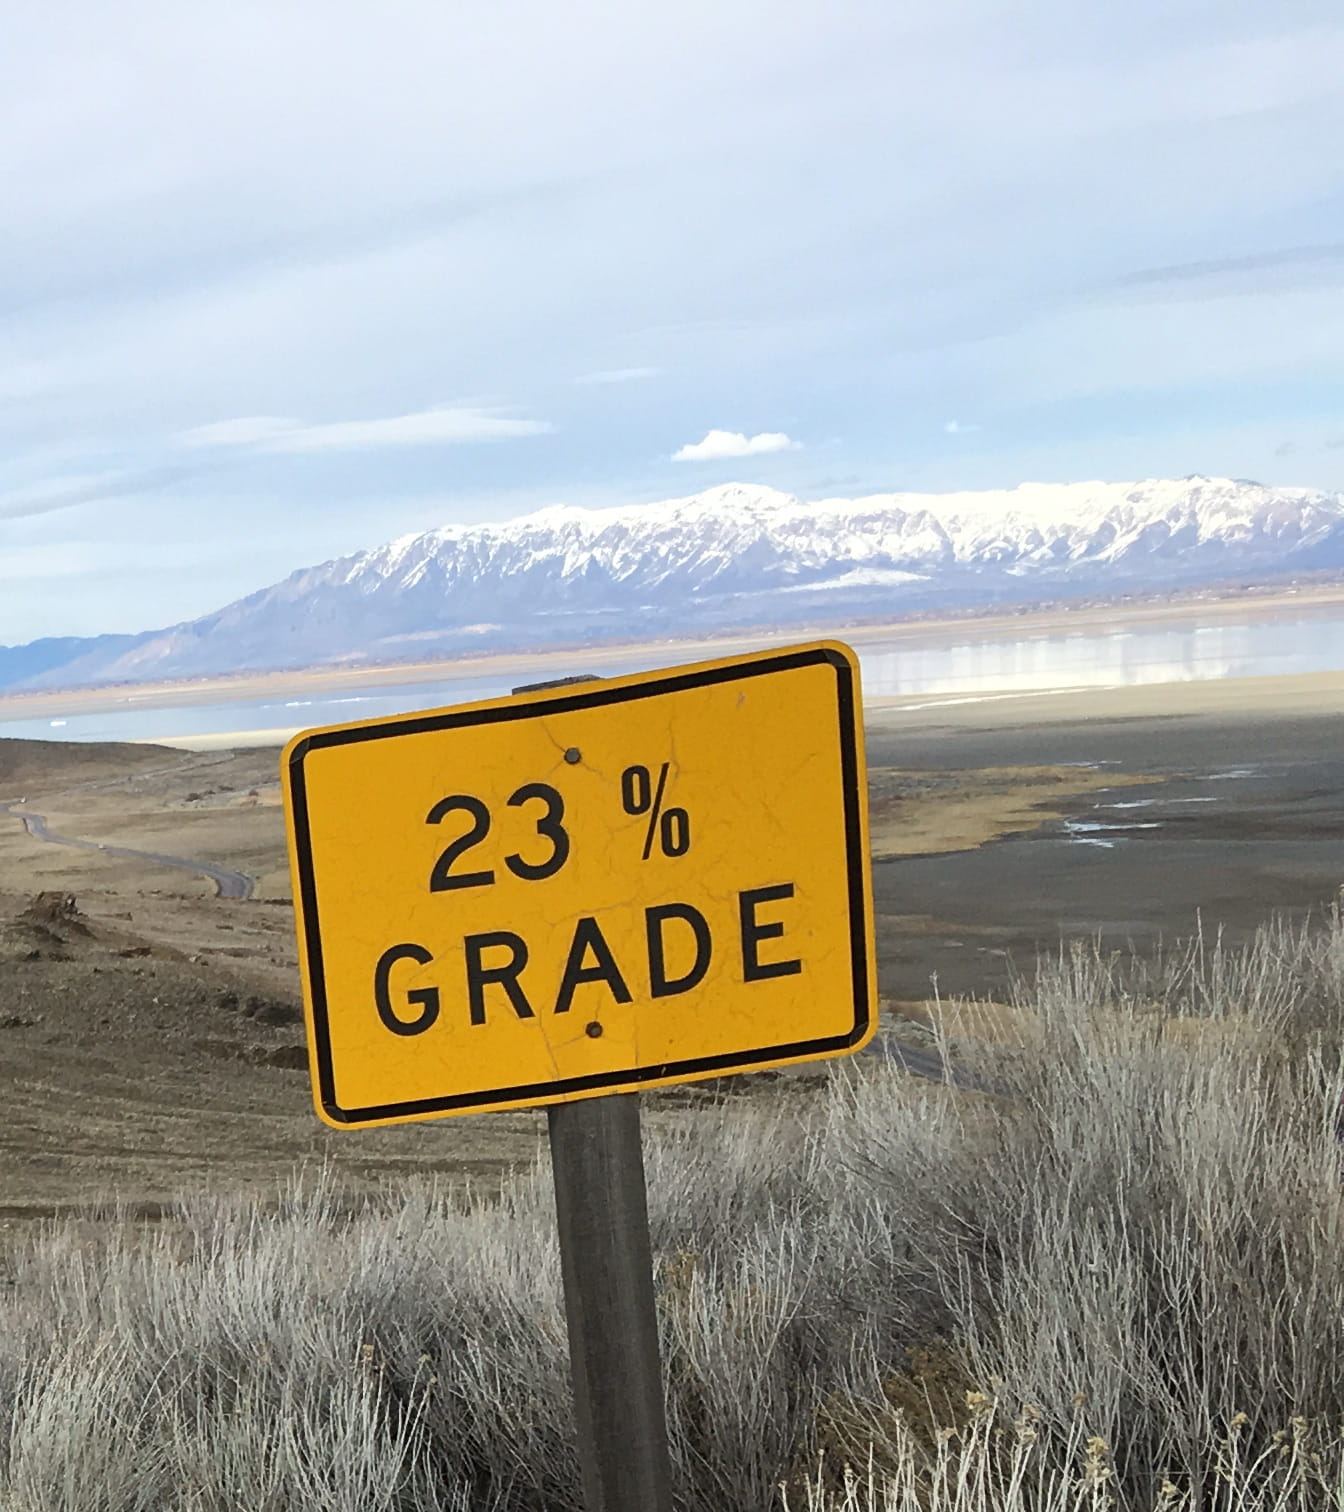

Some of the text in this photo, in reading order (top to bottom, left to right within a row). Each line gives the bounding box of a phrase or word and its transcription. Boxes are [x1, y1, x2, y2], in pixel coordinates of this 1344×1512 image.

[425, 762, 691, 893] 23 %
[374, 882, 803, 1037] GRADE
